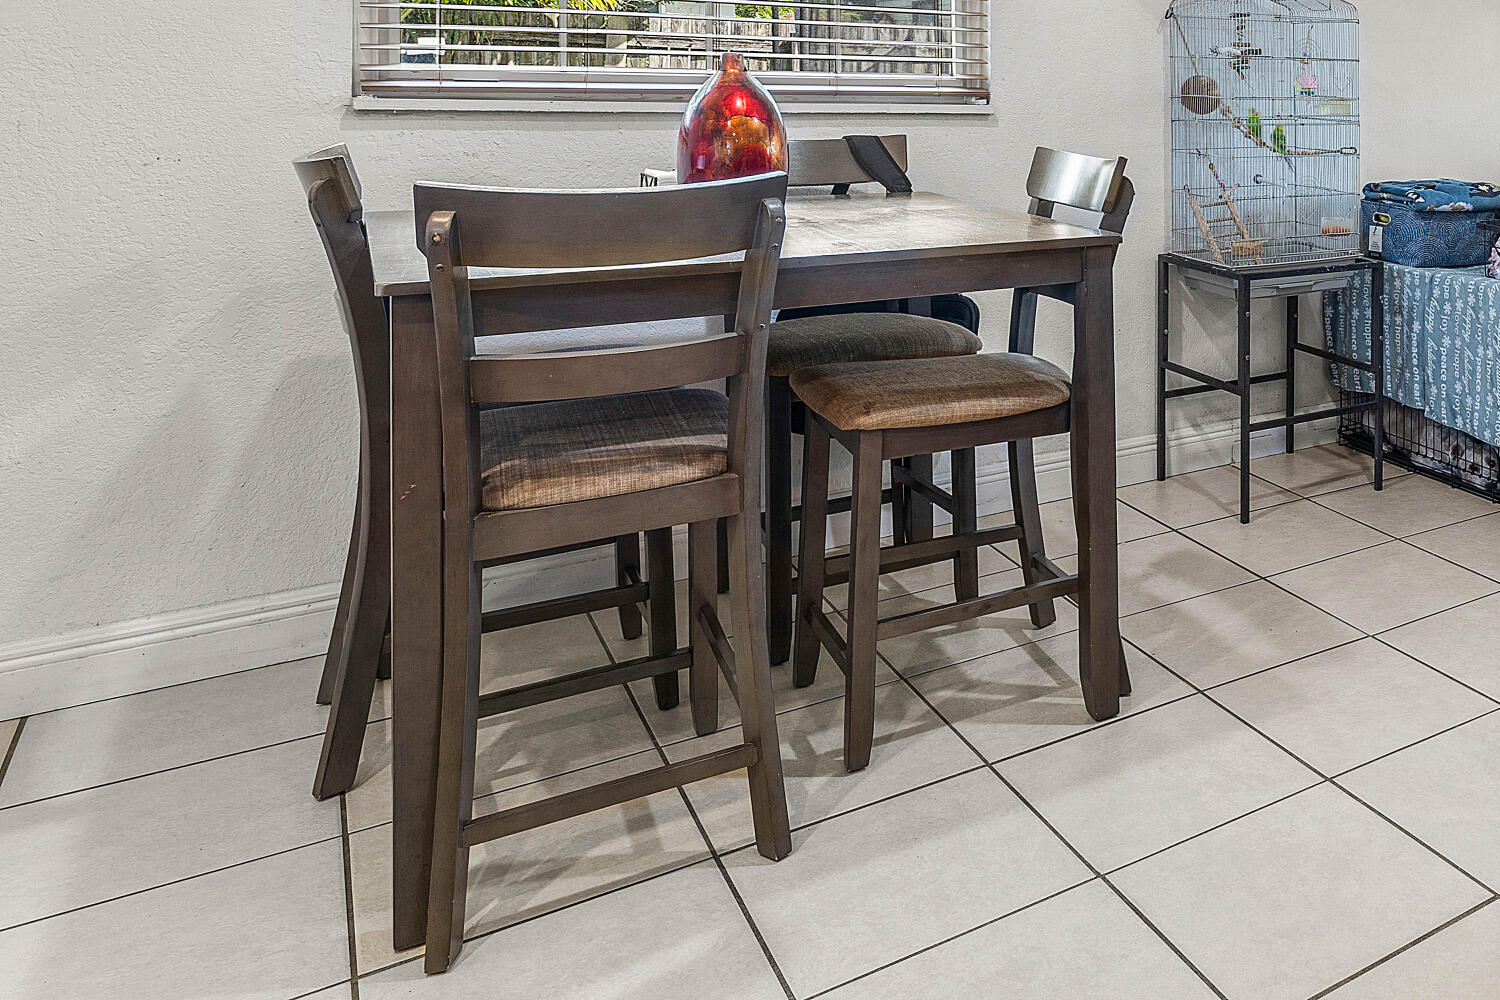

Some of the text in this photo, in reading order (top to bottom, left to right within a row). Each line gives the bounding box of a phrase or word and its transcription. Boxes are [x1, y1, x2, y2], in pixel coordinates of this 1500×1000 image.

[1363, 284, 1371, 306] love
[1425, 297, 1440, 334] happy
[1440, 315, 1450, 334] joy
[1462, 305, 1476, 343] happy
[1324, 318, 1334, 346] peace
[1363, 320, 1372, 346] hope
[1475, 324, 1483, 344] joy
[1352, 352, 1358, 360] o
[1411, 332, 1419, 365] peace
[1386, 359, 1391, 372] on
[1425, 337, 1438, 383] holidays
[1453, 349, 1461, 378] hope
[1462, 346, 1474, 393] holidays
[1413, 367, 1420, 381] on
[1441, 384, 1447, 398] on
[1453, 394, 1461, 414] joy
[1474, 394, 1481, 410] on
[1484, 406, 1492, 427] joy
